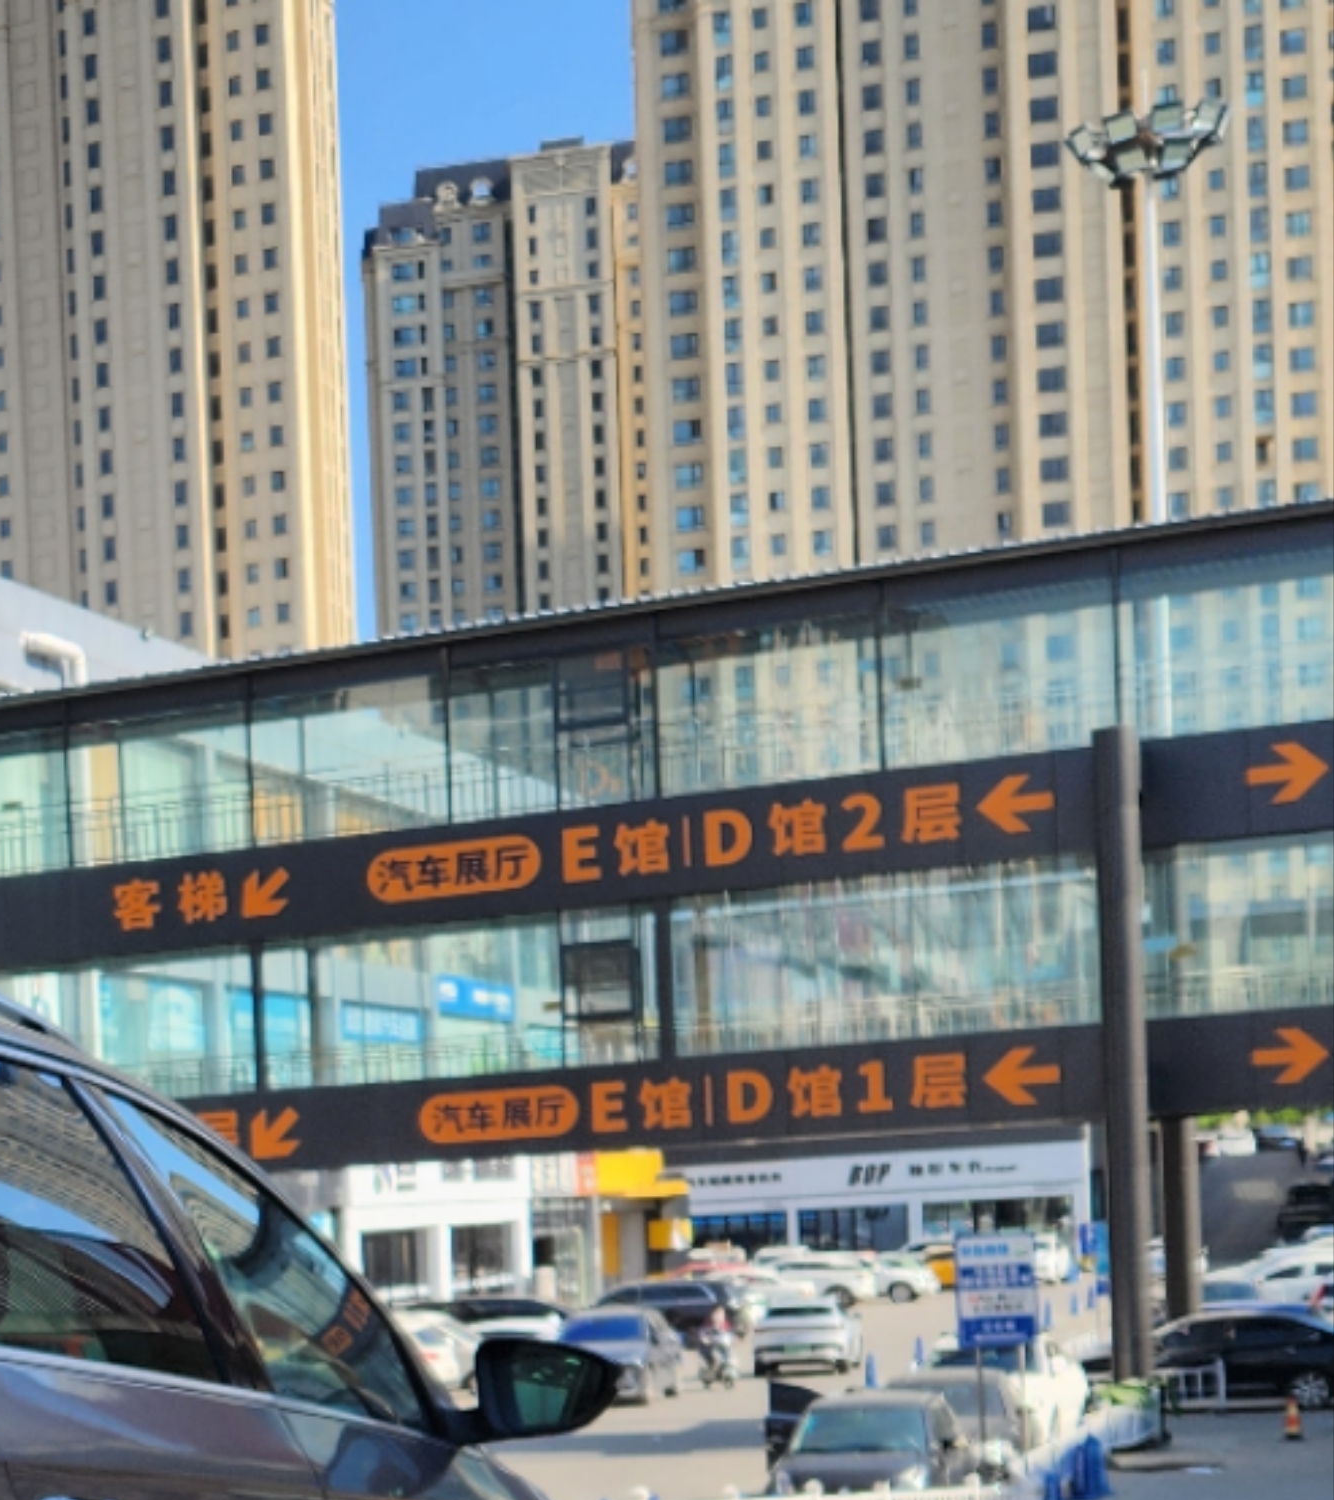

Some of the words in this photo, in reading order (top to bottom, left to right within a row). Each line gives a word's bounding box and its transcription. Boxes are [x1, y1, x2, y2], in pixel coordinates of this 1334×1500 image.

[112, 870, 228, 932] 客梯
[377, 844, 530, 895] 汽车展厅
[433, 1095, 566, 1134] 汽车展厅
